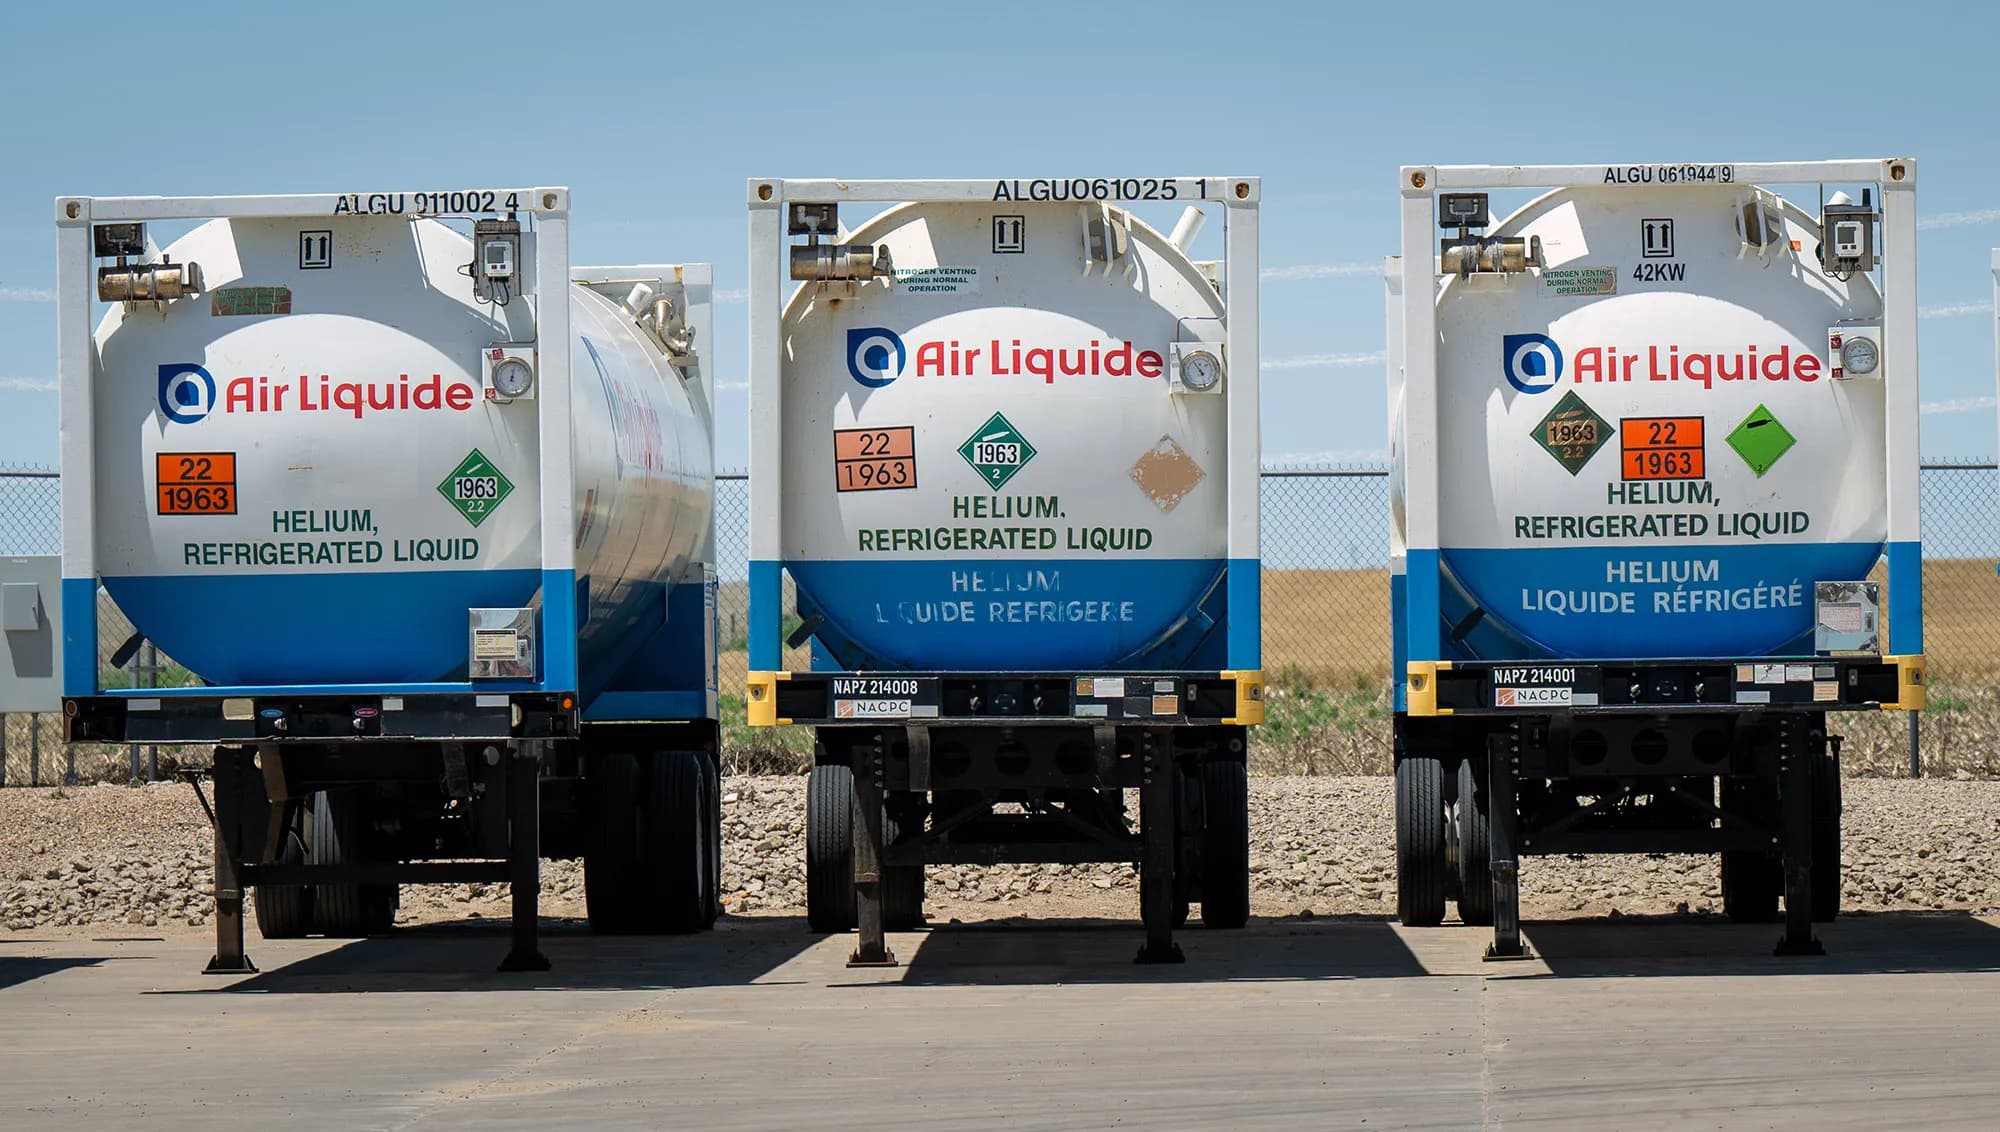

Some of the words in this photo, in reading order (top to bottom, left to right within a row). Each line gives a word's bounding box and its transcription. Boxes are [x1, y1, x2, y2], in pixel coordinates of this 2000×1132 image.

[1604, 167, 1652, 183] ALGU
[1659, 166, 1716, 182] 061944
[1721, 165, 1731, 182] 9
[334, 193, 404, 215] ALGU
[505, 192, 519, 212] 4
[891, 268, 936, 276] NITROGEN
[897, 276, 930, 284] DURING
[1543, 270, 1579, 278] NITROGEN
[1547, 279, 1574, 287] DURING
[1577, 277, 1606, 285] NORMAL
[1633, 263, 1685, 282] 42KW
[1556, 286, 1598, 294] OPERATION
[917, 341, 980, 377] Air
[992, 340, 1163, 384] Liquide
[1574, 347, 1638, 383] Air
[1649, 345, 1821, 389] Liquide
[227, 376, 288, 413] Air
[301, 374, 473, 418] Liquide
[1550, 424, 1594, 442] 1963
[1649, 422, 1677, 445] 22
[860, 434, 891, 457] 22
[977, 444, 1017, 463] 1963
[180, 458, 212, 481] 22
[844, 462, 908, 487] 1963
[993, 468, 1000, 479] 2
[1635, 452, 1692, 476] 1963
[165, 487, 229, 511] 1963
[456, 478, 496, 498] 1963
[1608, 482, 1720, 505] HELIUM,
[467, 501, 484, 513] 2.2
[272, 510, 379, 537] HELIUM,
[1515, 513, 1708, 538] REFRIGERATED
[1718, 511, 1809, 538] LIQUID
[859, 528, 1057, 551] REFRIGERATED
[1067, 527, 1153, 552] LIQUID
[184, 541, 383, 565] REFRIGERATED
[393, 538, 479, 563] LIQUID
[1606, 560, 1719, 583] HELIUM
[1522, 589, 1635, 614] LIQUIDE
[1654, 578, 1802, 613] RÉFRIGÉRÉ
[834, 680, 867, 695] NAPZ
[870, 680, 918, 695] 214008
[1494, 669, 1527, 684] NAPZ
[1530, 668, 1576, 683] 214001
[857, 701, 909, 713] NACPC
[1518, 690, 1569, 701] NACPC
